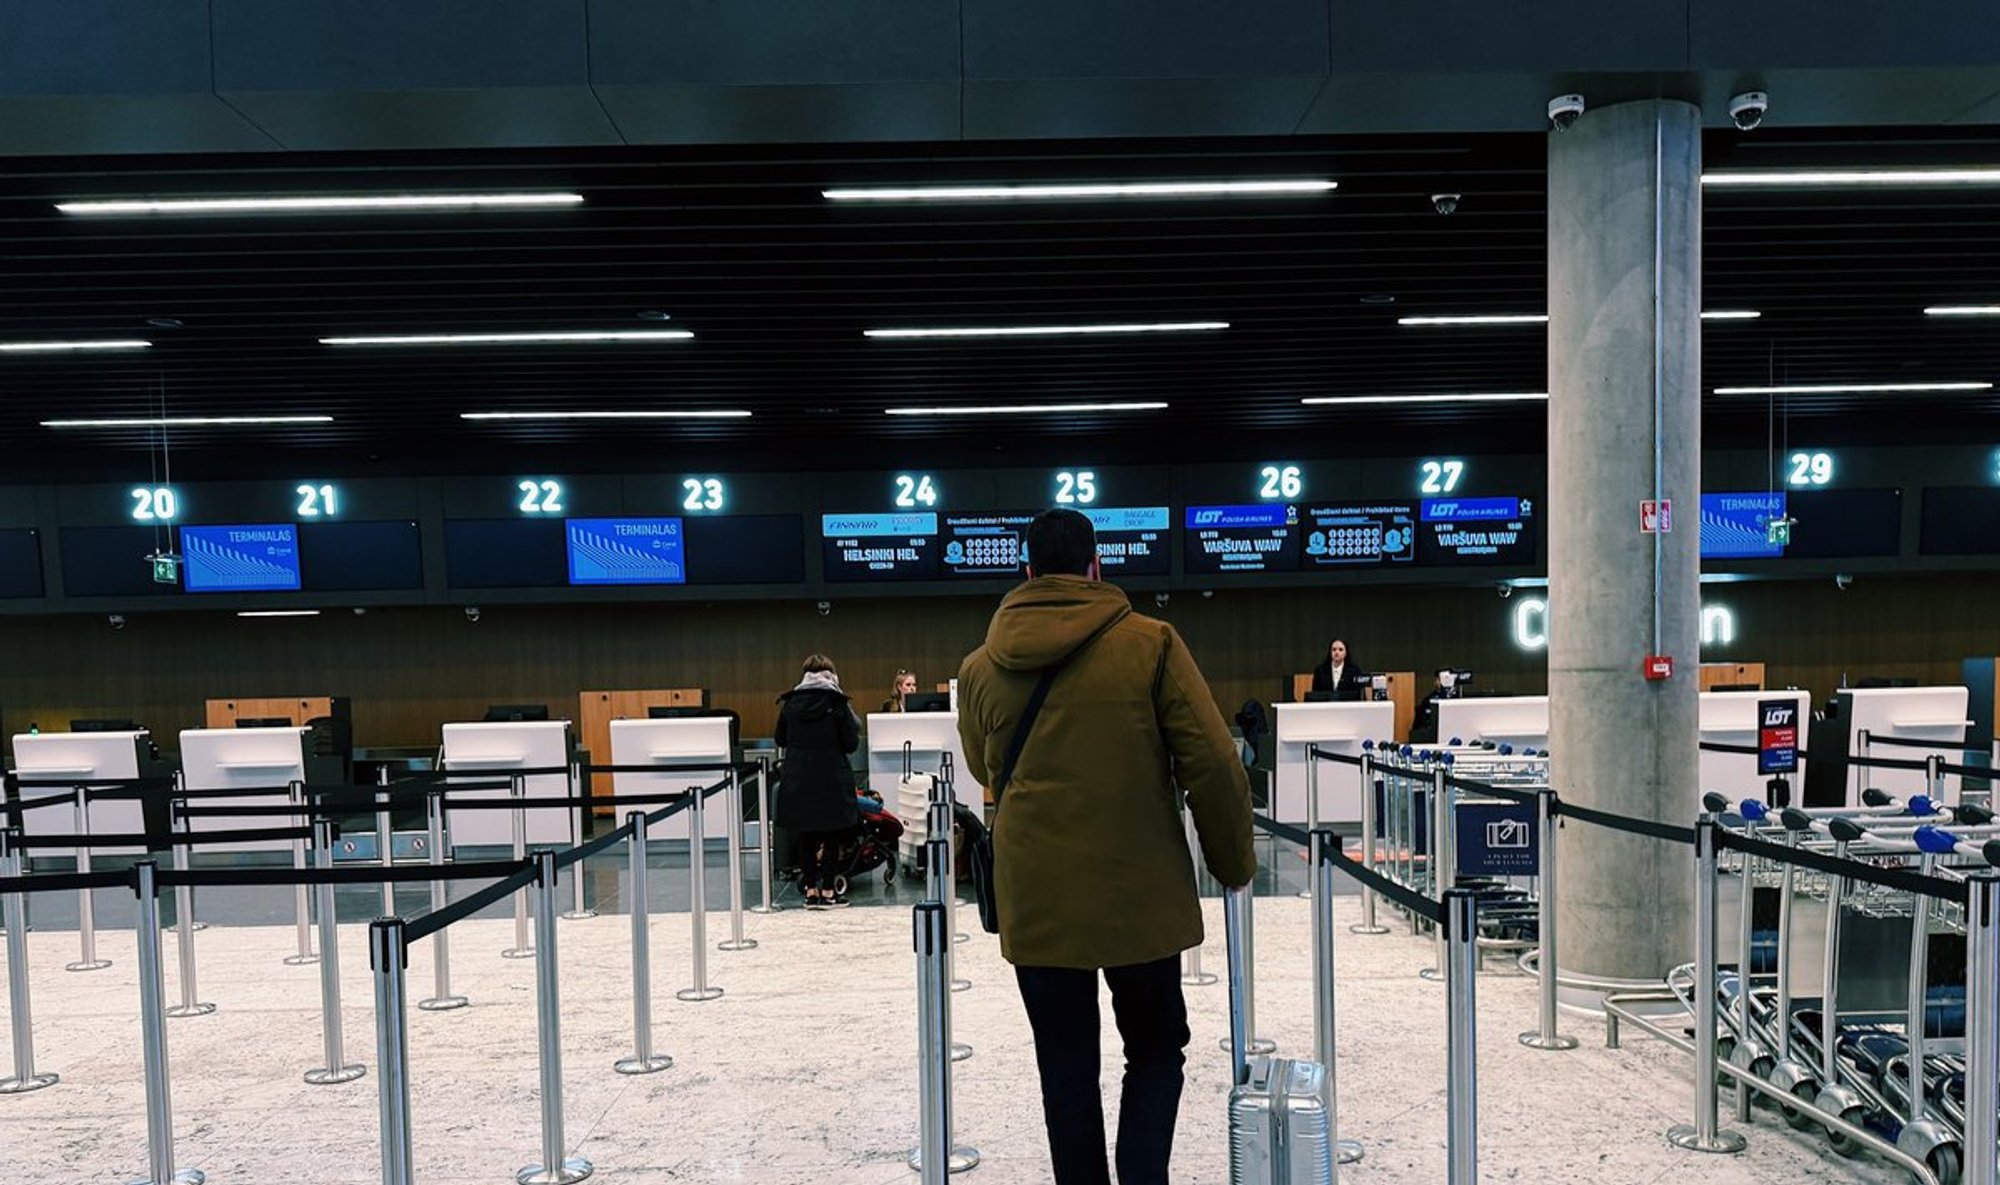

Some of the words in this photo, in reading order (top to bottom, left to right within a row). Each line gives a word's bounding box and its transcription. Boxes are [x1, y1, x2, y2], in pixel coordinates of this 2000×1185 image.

[1790, 453, 1832, 484] 29
[1260, 466, 1301, 498] 26
[1422, 461, 1463, 493] 27
[519, 480, 562, 511] 22
[683, 479, 723, 510] 23
[896, 475, 936, 507] 24
[1055, 472, 1095, 503] 25
[131, 488, 175, 519] 20
[296, 484, 335, 515] 21
[1720, 498, 1780, 511] TERMINALAS
[1195, 510, 1223, 524] LOT
[1429, 503, 1459, 517] LOT
[1480, 508, 1508, 516] AIRLINES
[614, 524, 676, 536] TERMINALAS
[829, 520, 879, 530] FINNAIR
[229, 531, 291, 543] TERMINALAS
[1203, 537, 1252, 553] VARŠUVA
[1253, 538, 1282, 552] WAW
[1438, 530, 1488, 547] VARŠUVA
[1488, 531, 1517, 545] WAW
[843, 548, 895, 561] HELSINKI
[896, 548, 919, 560] HEL
[1096, 542, 1126, 556] SINKI
[1128, 542, 1150, 555] HEL
[1765, 709, 1793, 725] LOT
